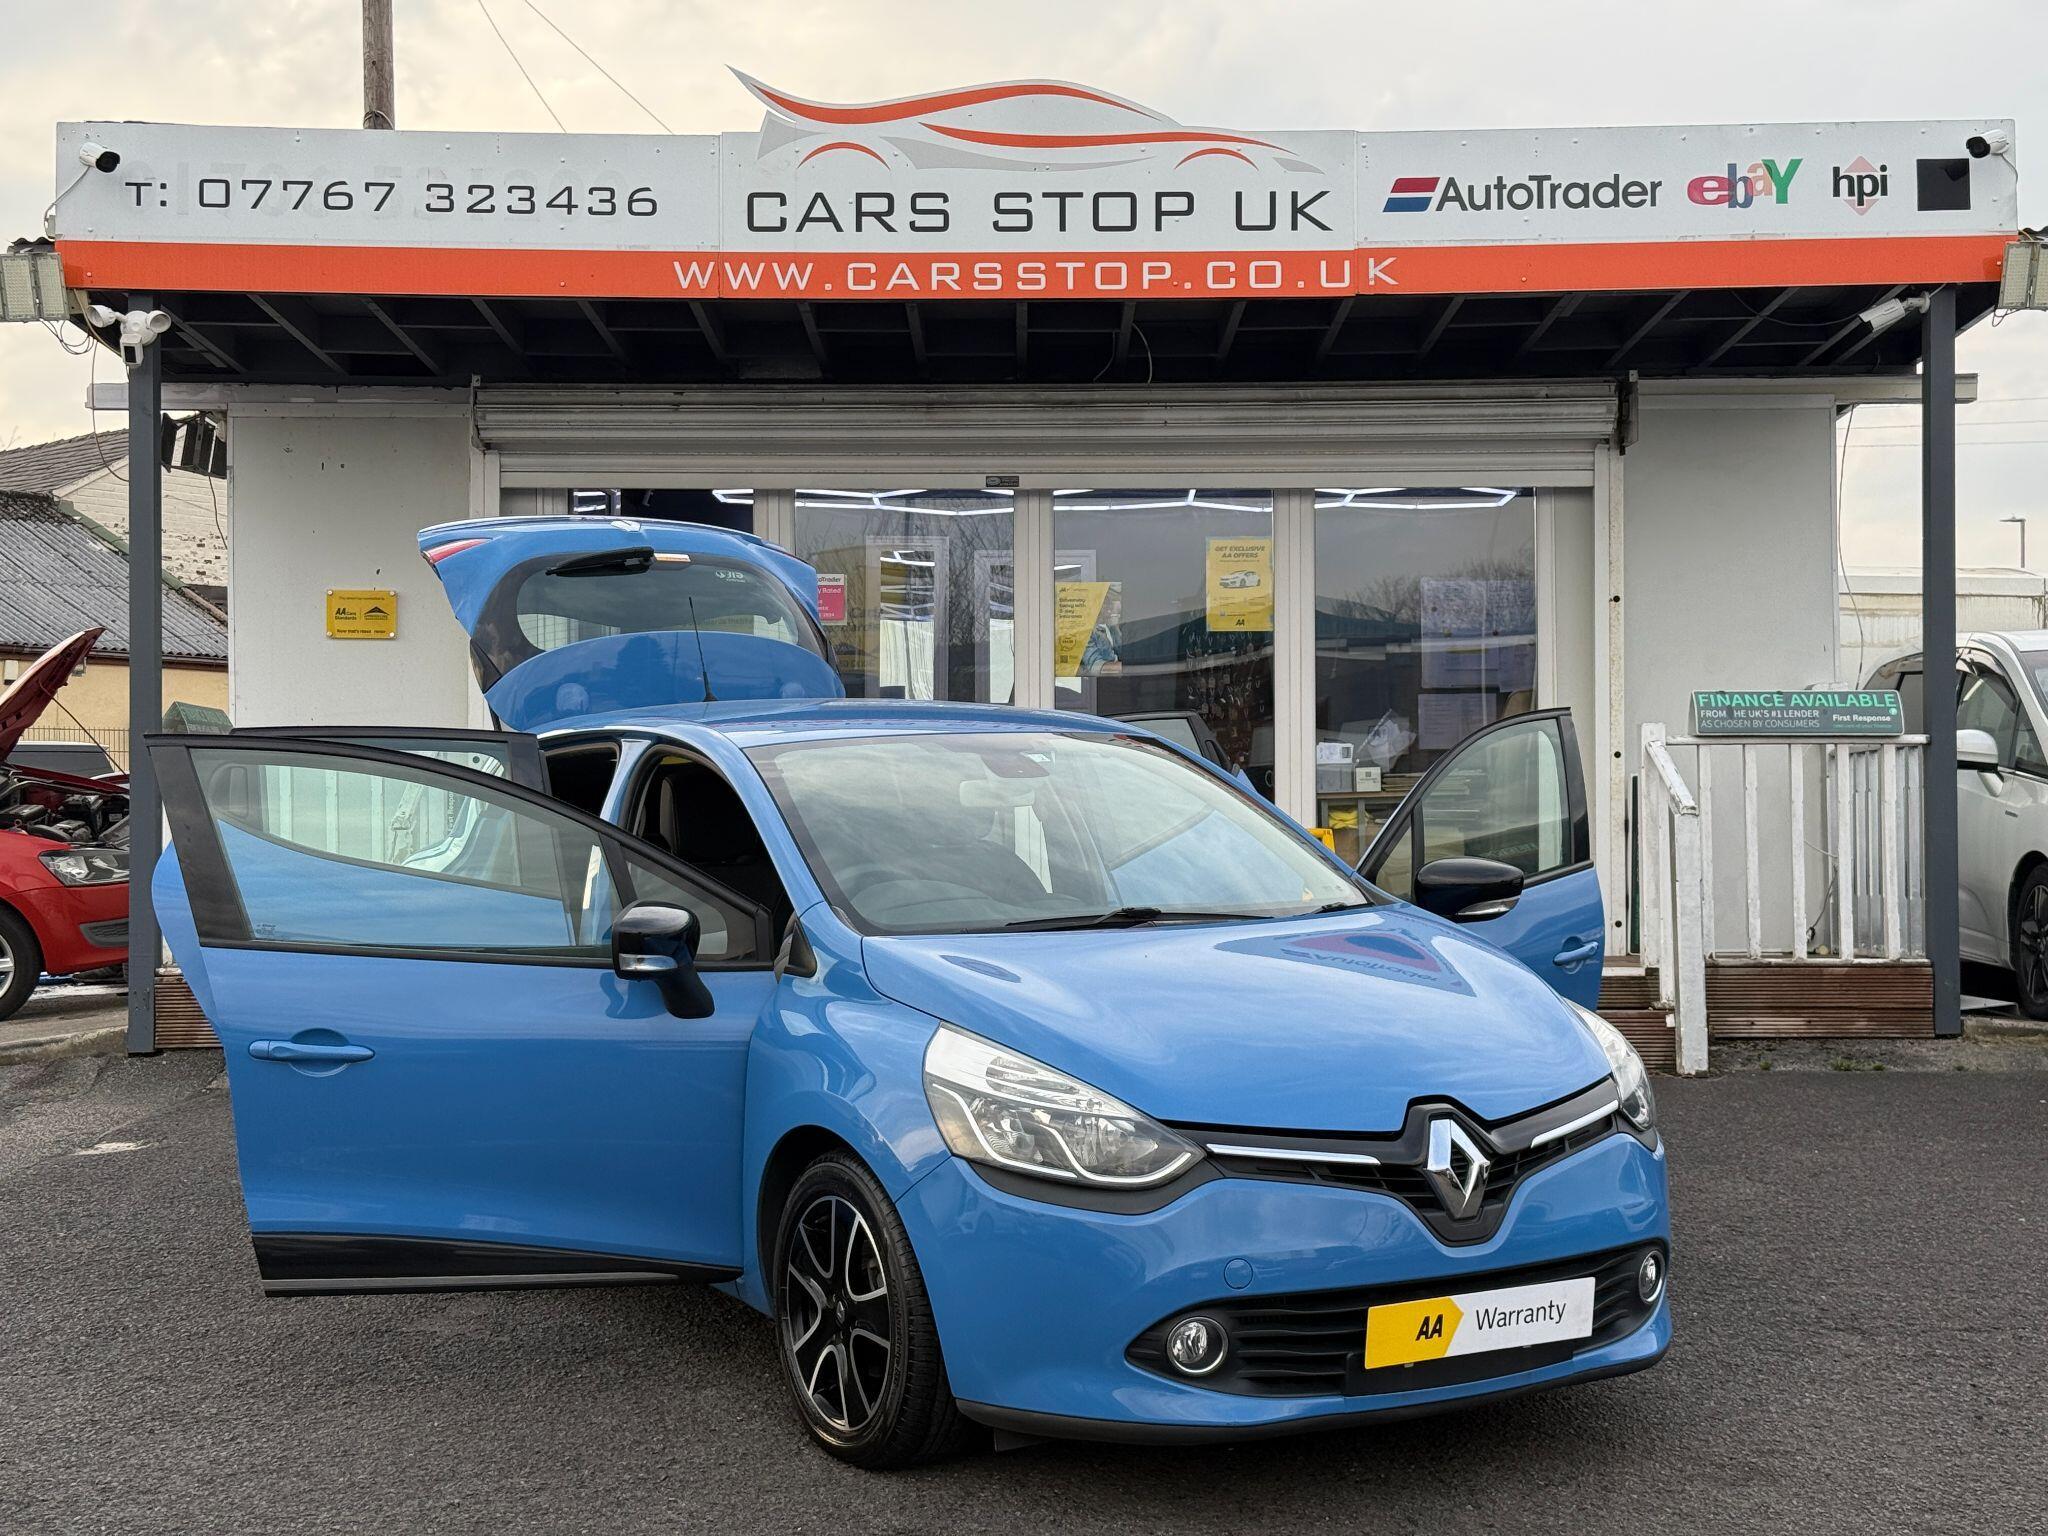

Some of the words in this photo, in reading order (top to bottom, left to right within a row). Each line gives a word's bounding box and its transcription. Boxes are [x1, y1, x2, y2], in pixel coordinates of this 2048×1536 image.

[124, 181, 167, 207] T:
[198, 178, 396, 212] 07767
[425, 183, 658, 217] 323436
[1434, 173, 1663, 212] AutoTrader
[1832, 164, 1888, 206] hpi
[747, 191, 950, 233] CARS
[992, 191, 1195, 233] STOP
[1235, 190, 1333, 232] UK
[673, 256, 1399, 291] WWW.CARSSTOP.CO.UK
[1698, 693, 1786, 708] FINANCE
[1790, 693, 1897, 708] AVAILABLE
[1700, 709, 1727, 718] FROM
[1748, 709, 1770, 718] UK'S
[1783, 709, 1820, 718] LENDER
[1832, 713, 1851, 722] First
[1852, 713, 1892, 724] Response
[1700, 719, 1712, 729] AS
[1713, 719, 1751, 729] CHOSEN
[1752, 719, 1764, 729] BY
[1764, 719, 1821, 729] CONSUMERS
[1414, 1313, 1444, 1342] AA
[1475, 1299, 1568, 1331] Warranty
